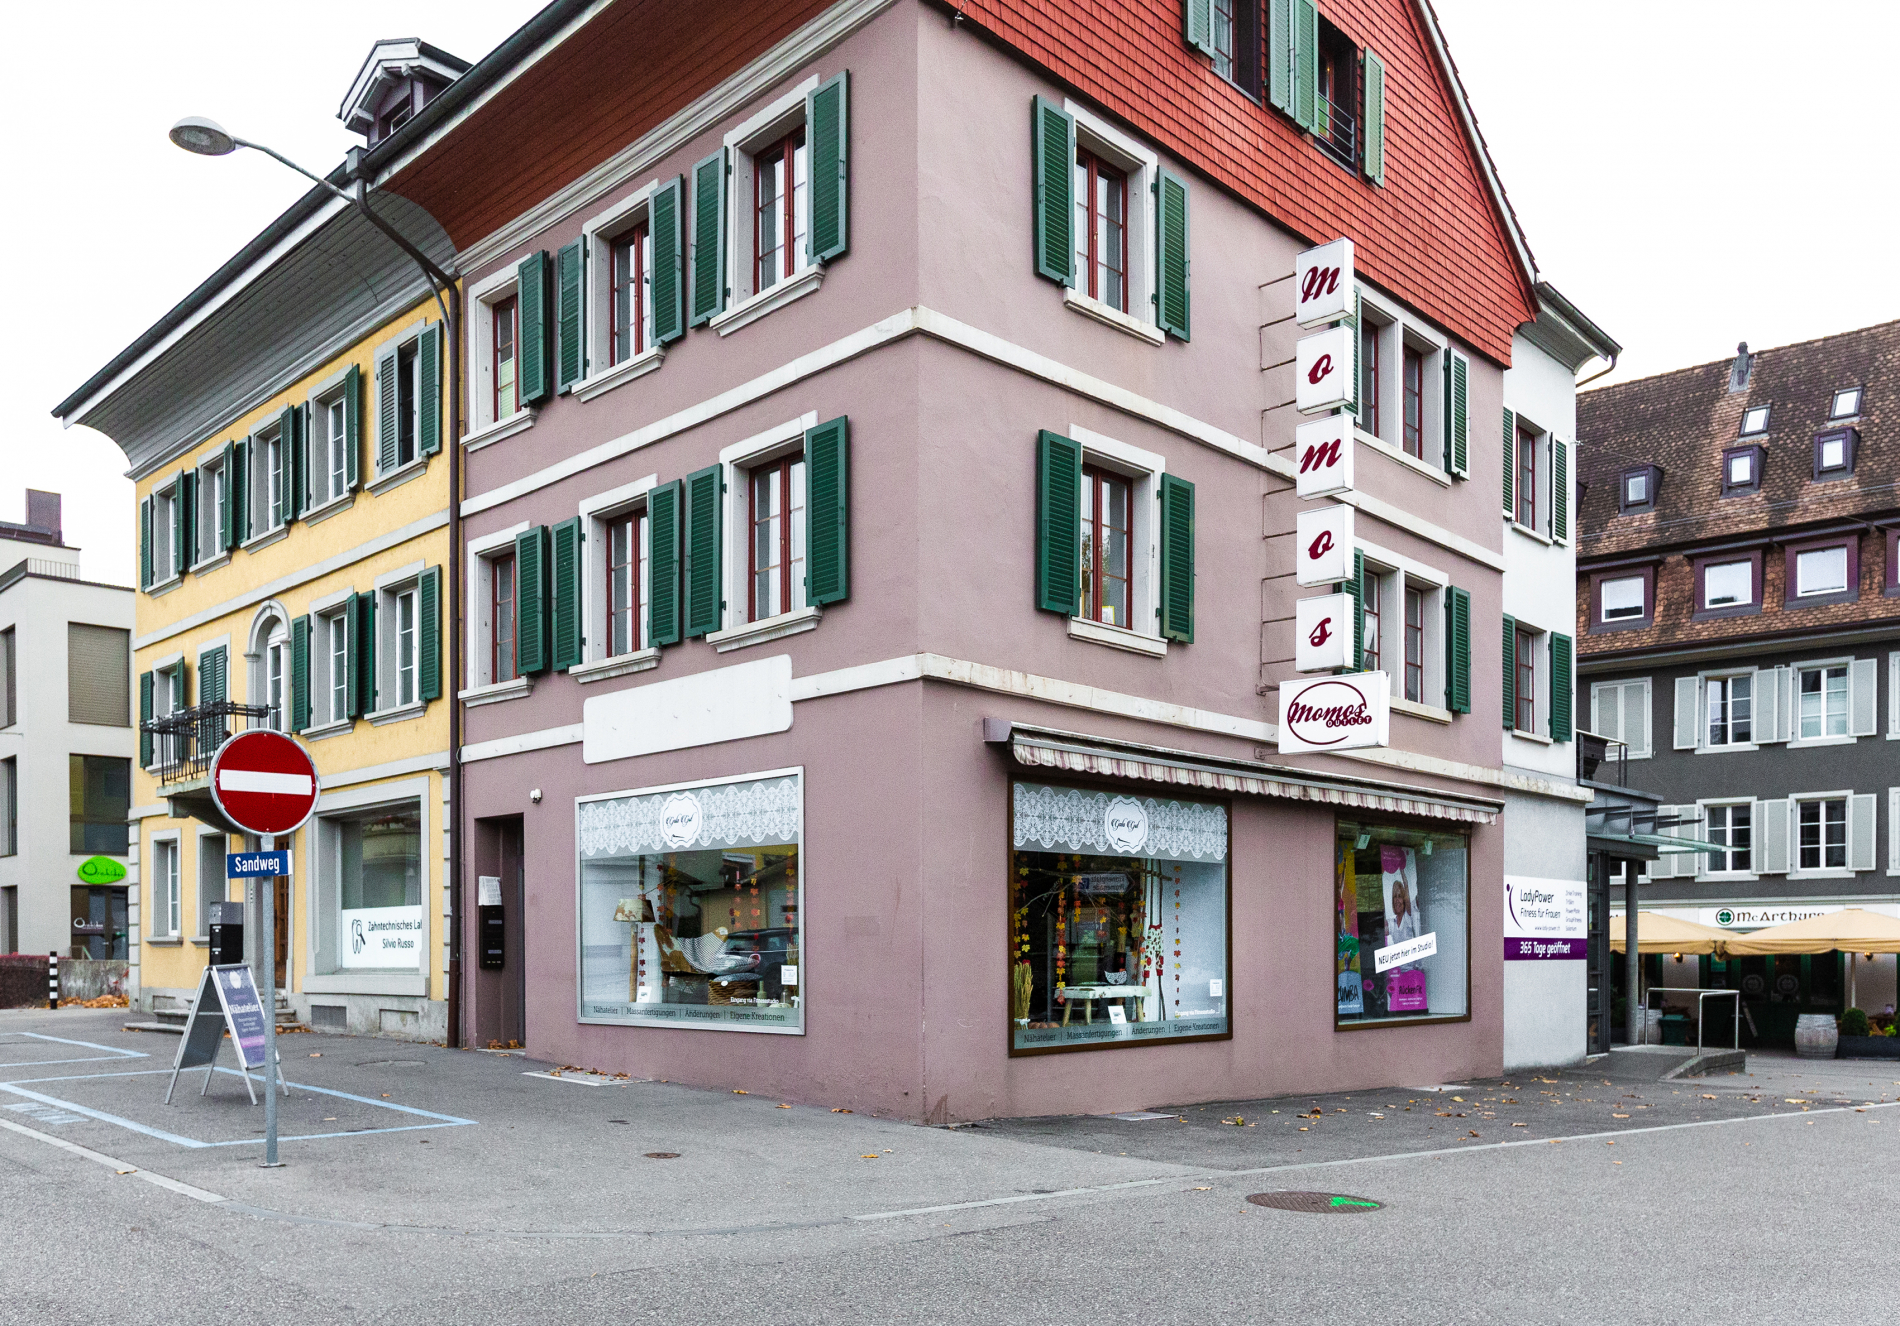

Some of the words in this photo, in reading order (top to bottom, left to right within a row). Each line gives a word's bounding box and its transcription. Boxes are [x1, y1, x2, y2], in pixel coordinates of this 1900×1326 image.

[1288, 701, 1367, 724] Momos
[1326, 715, 1372, 728] OUTLET
[235, 855, 279, 874] Sandweg
[1520, 889, 1554, 906] LadyPower
[1520, 907, 1537, 918] Fitness
[1545, 908, 1561, 919] Frauen
[368, 919, 413, 932] Zahntechnisches
[382, 938, 397, 949] Silvio
[397, 937, 415, 949] Russo
[1520, 941, 1533, 954] 365
[1533, 941, 1546, 958] Tage
[1546, 941, 1571, 958] geöffnet
[1378, 953, 1389, 965] NEU
[1400, 948, 1411, 959] hier
[1417, 940, 1434, 953] Studio!
[729, 1010, 751, 1021] Eigene
[751, 1011, 785, 1022] Kreationen
